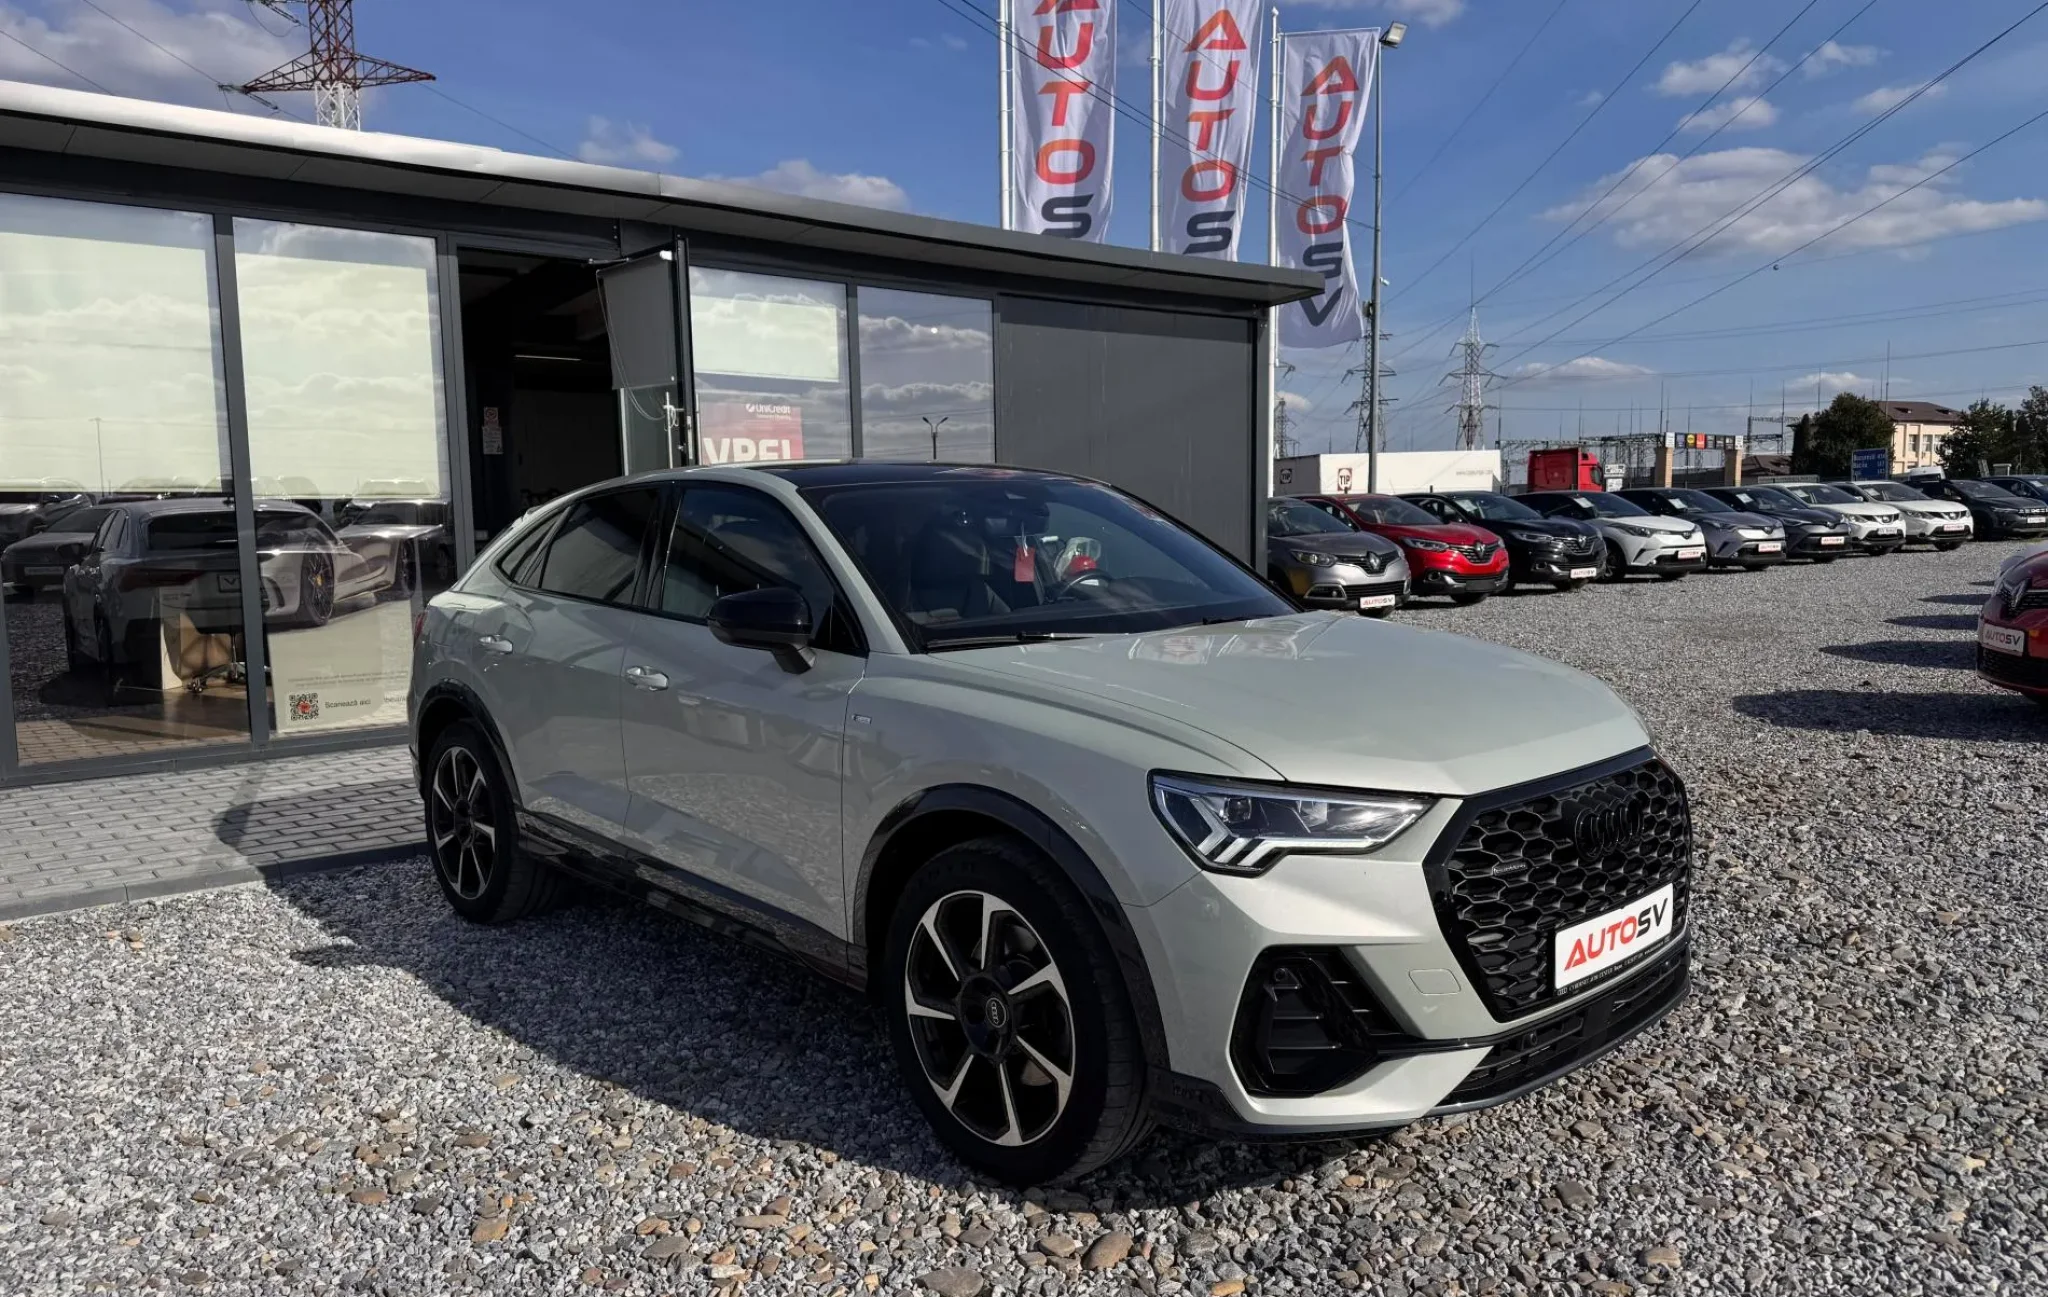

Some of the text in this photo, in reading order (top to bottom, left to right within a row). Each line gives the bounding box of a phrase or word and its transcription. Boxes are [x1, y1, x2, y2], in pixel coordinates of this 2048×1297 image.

[1033, 0, 1100, 239] UTOS
[1181, 9, 1247, 255] AUTOS
[1296, 55, 1360, 327] AUTOSV
[756, 404, 791, 414] UniCredit
[1340, 475, 1350, 485] TIP
[1363, 597, 1393, 606] AUTOSV
[1985, 630, 2021, 646] AUTOSV
[1564, 897, 1668, 971] AUTOSV
